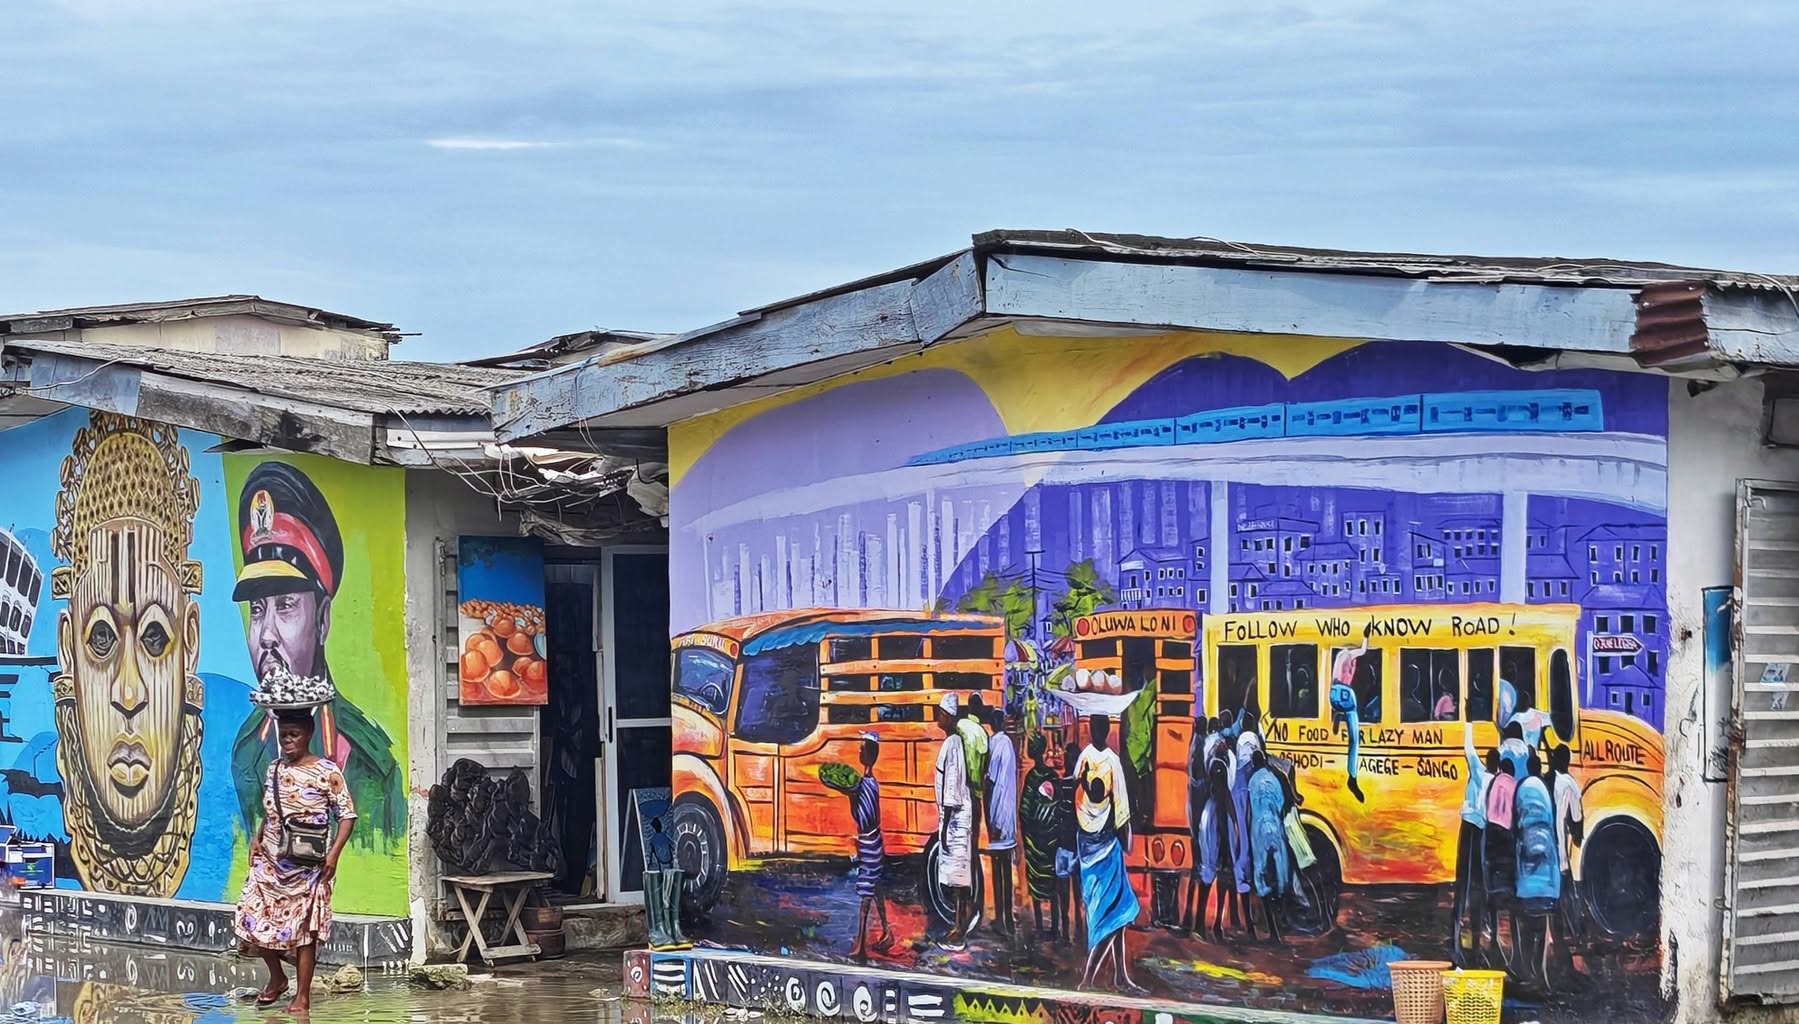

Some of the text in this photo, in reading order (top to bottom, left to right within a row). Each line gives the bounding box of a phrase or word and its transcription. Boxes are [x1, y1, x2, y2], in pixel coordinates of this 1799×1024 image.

[1091, 615, 1136, 636] OLUWA
[1224, 620, 1298, 642] FOLLOW
[1315, 617, 1350, 638] WHO
[1371, 614, 1432, 637] KNOW
[1273, 721, 1443, 745] NO FOOD FR LAZY MAN
[1359, 757, 1400, 776] AGEGE
